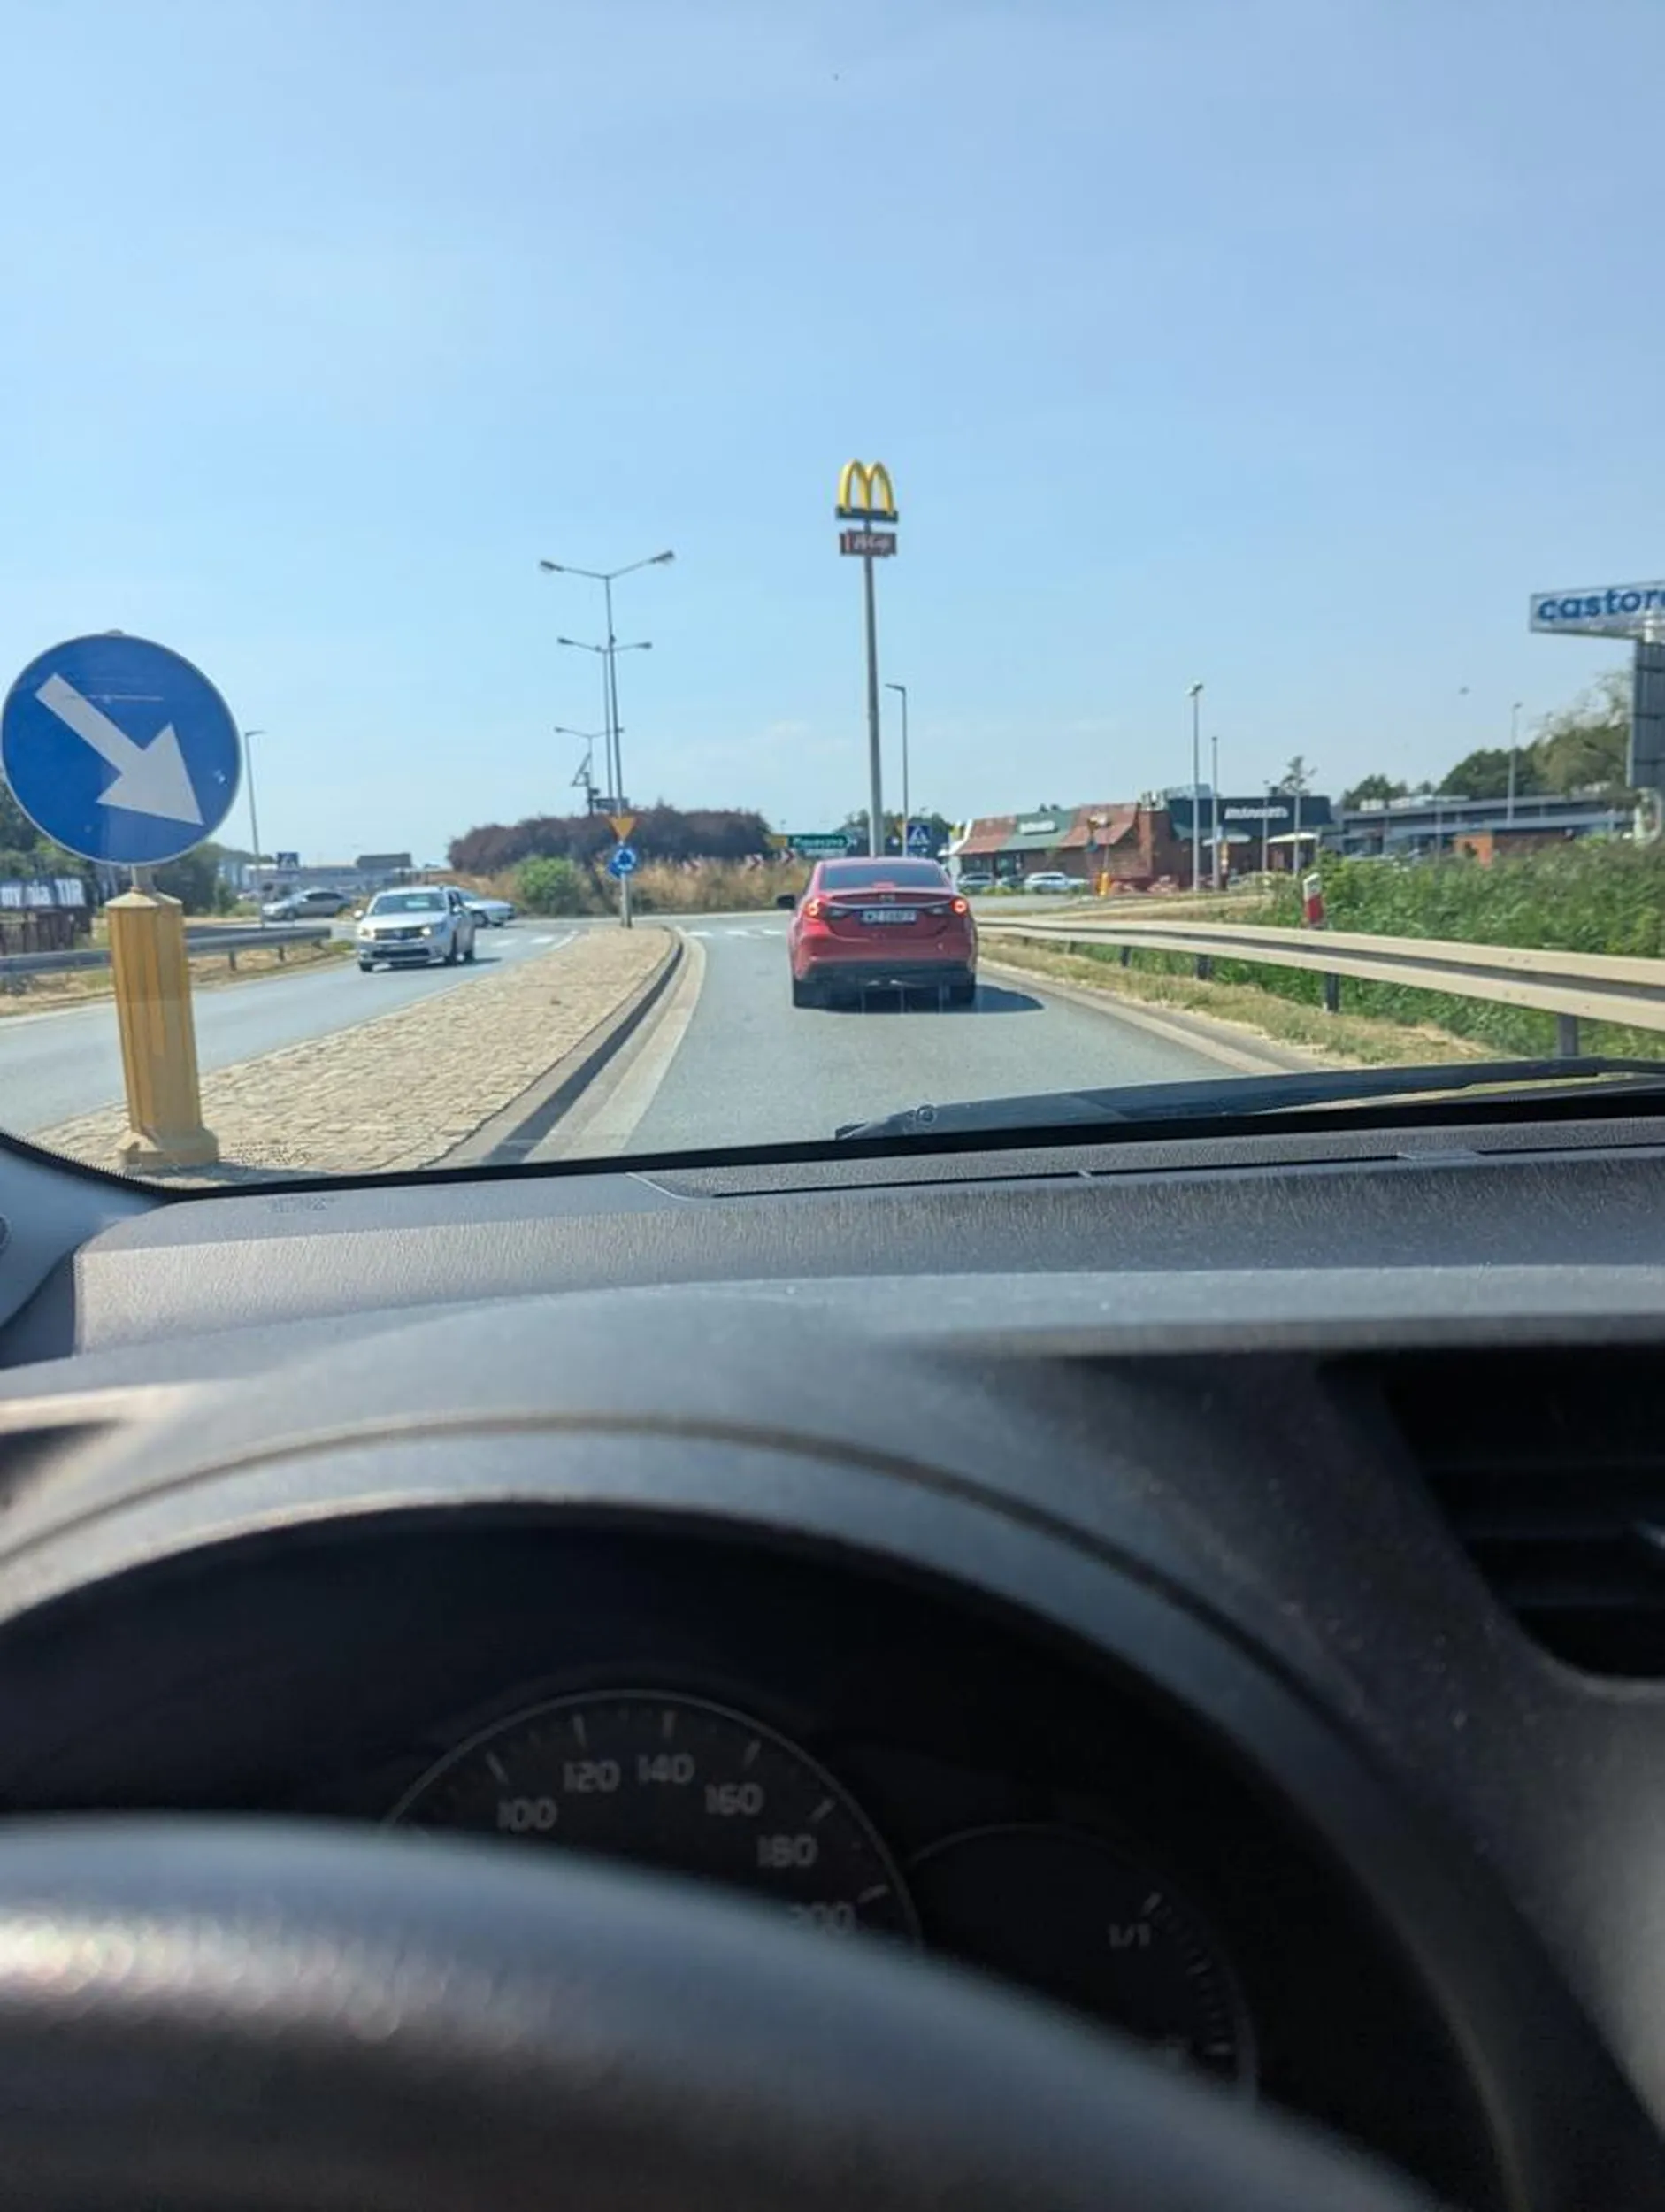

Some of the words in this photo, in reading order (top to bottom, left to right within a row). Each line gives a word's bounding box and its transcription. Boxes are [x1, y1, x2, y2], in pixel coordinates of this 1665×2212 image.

[1538, 588, 1665, 621] castor
[564, 1759, 621, 1793] 120
[636, 1753, 694, 1785] 140
[497, 1796, 558, 1832] 100
[705, 1782, 763, 1816] 160
[756, 1833, 818, 1868] 180
